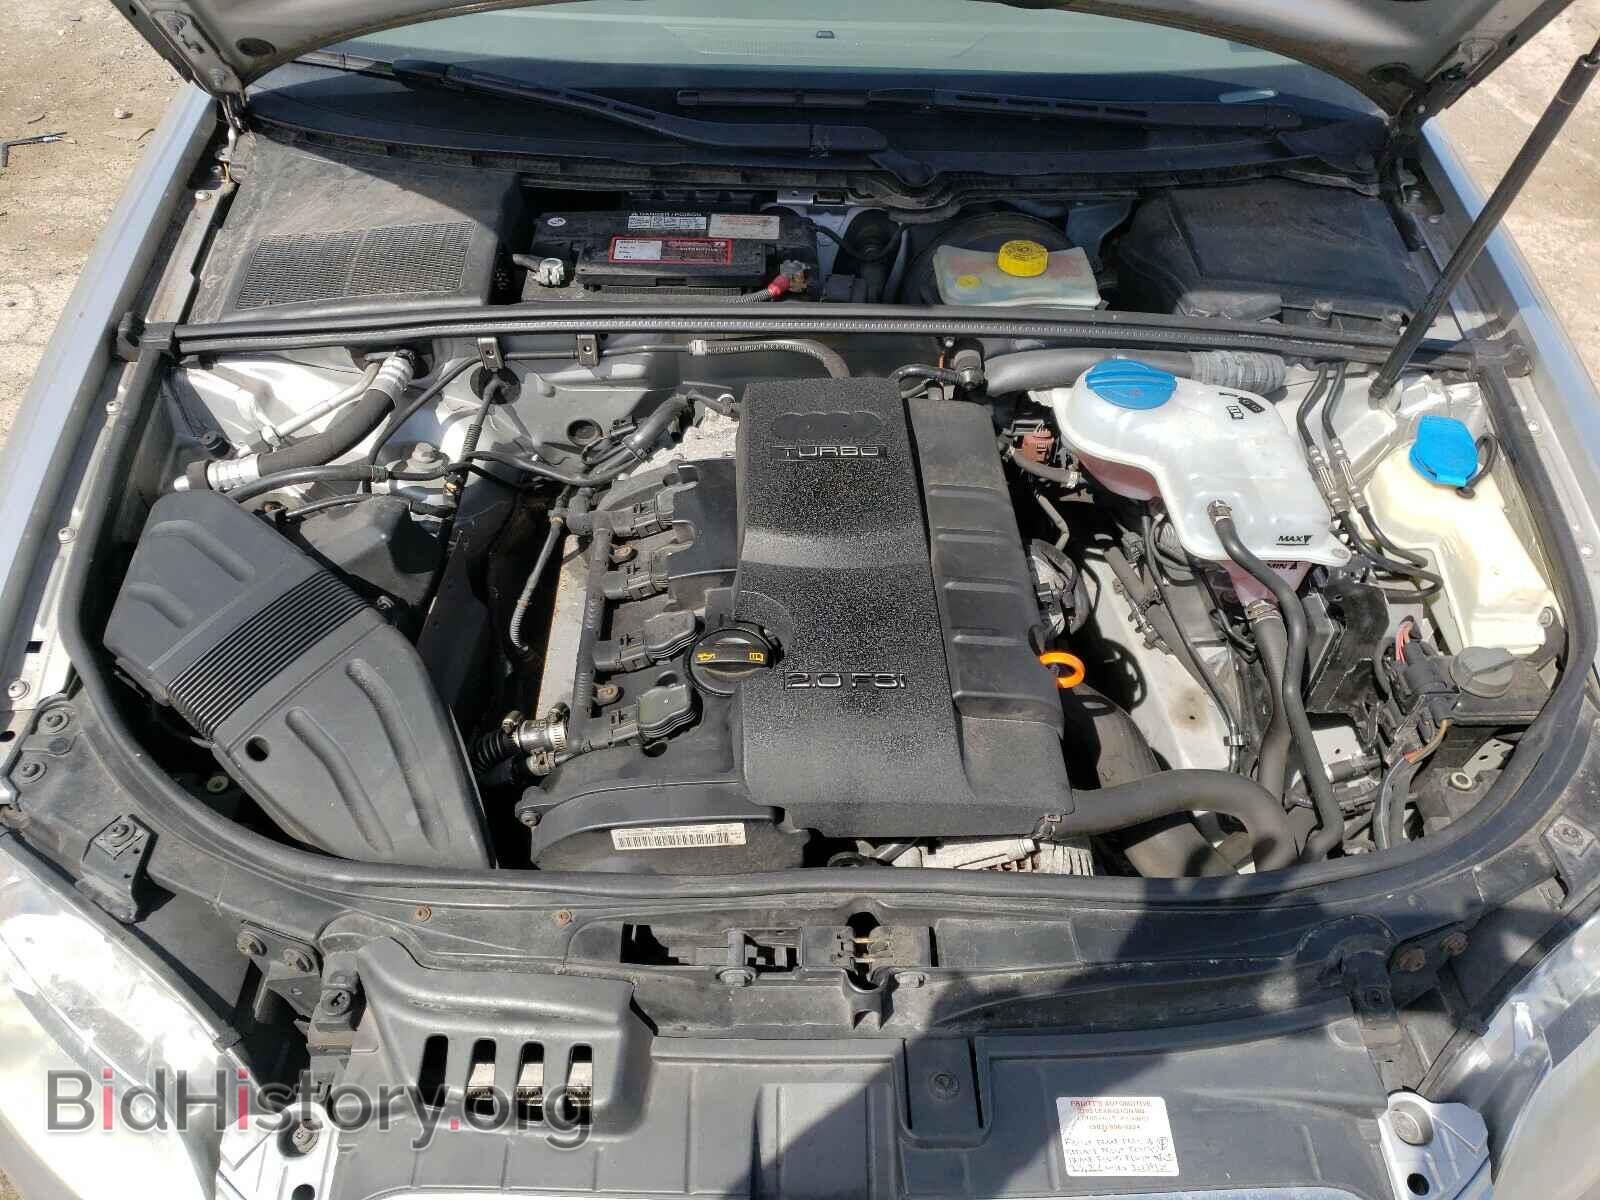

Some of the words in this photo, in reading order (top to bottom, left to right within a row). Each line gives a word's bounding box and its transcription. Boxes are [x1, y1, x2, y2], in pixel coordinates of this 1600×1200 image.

[783, 445, 880, 458] TURBO
[785, 673, 842, 689] 2.0
[850, 673, 907, 689] FSI
